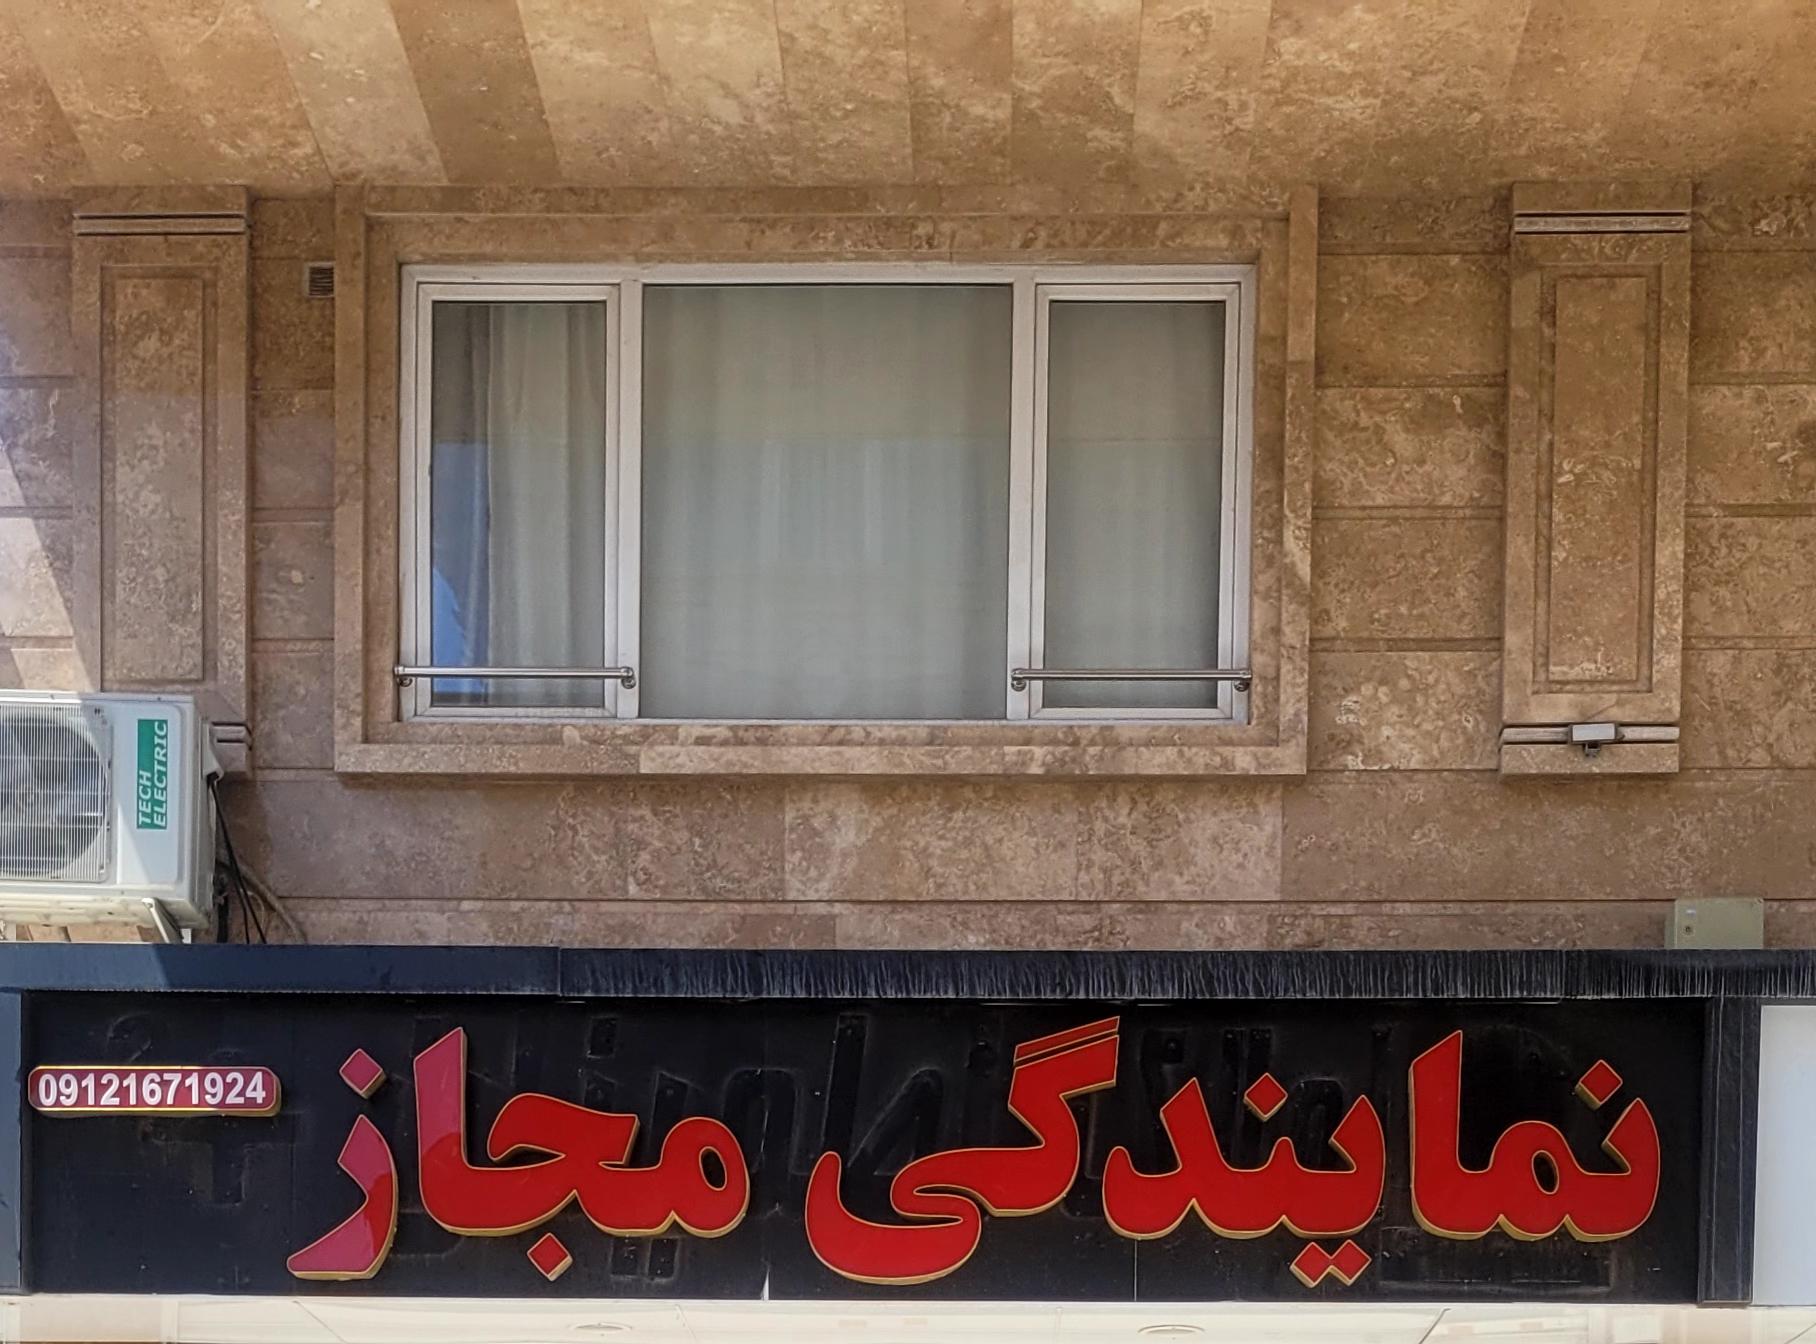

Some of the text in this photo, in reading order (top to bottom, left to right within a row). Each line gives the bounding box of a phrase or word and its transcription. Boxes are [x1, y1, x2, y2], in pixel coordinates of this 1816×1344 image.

[138, 769, 152, 826] TECH
[153, 721, 167, 827] ELECTRIC
[37, 1072, 267, 1108] 09121671924
[286, 1015, 1662, 1286] نمایندگی مجاز
